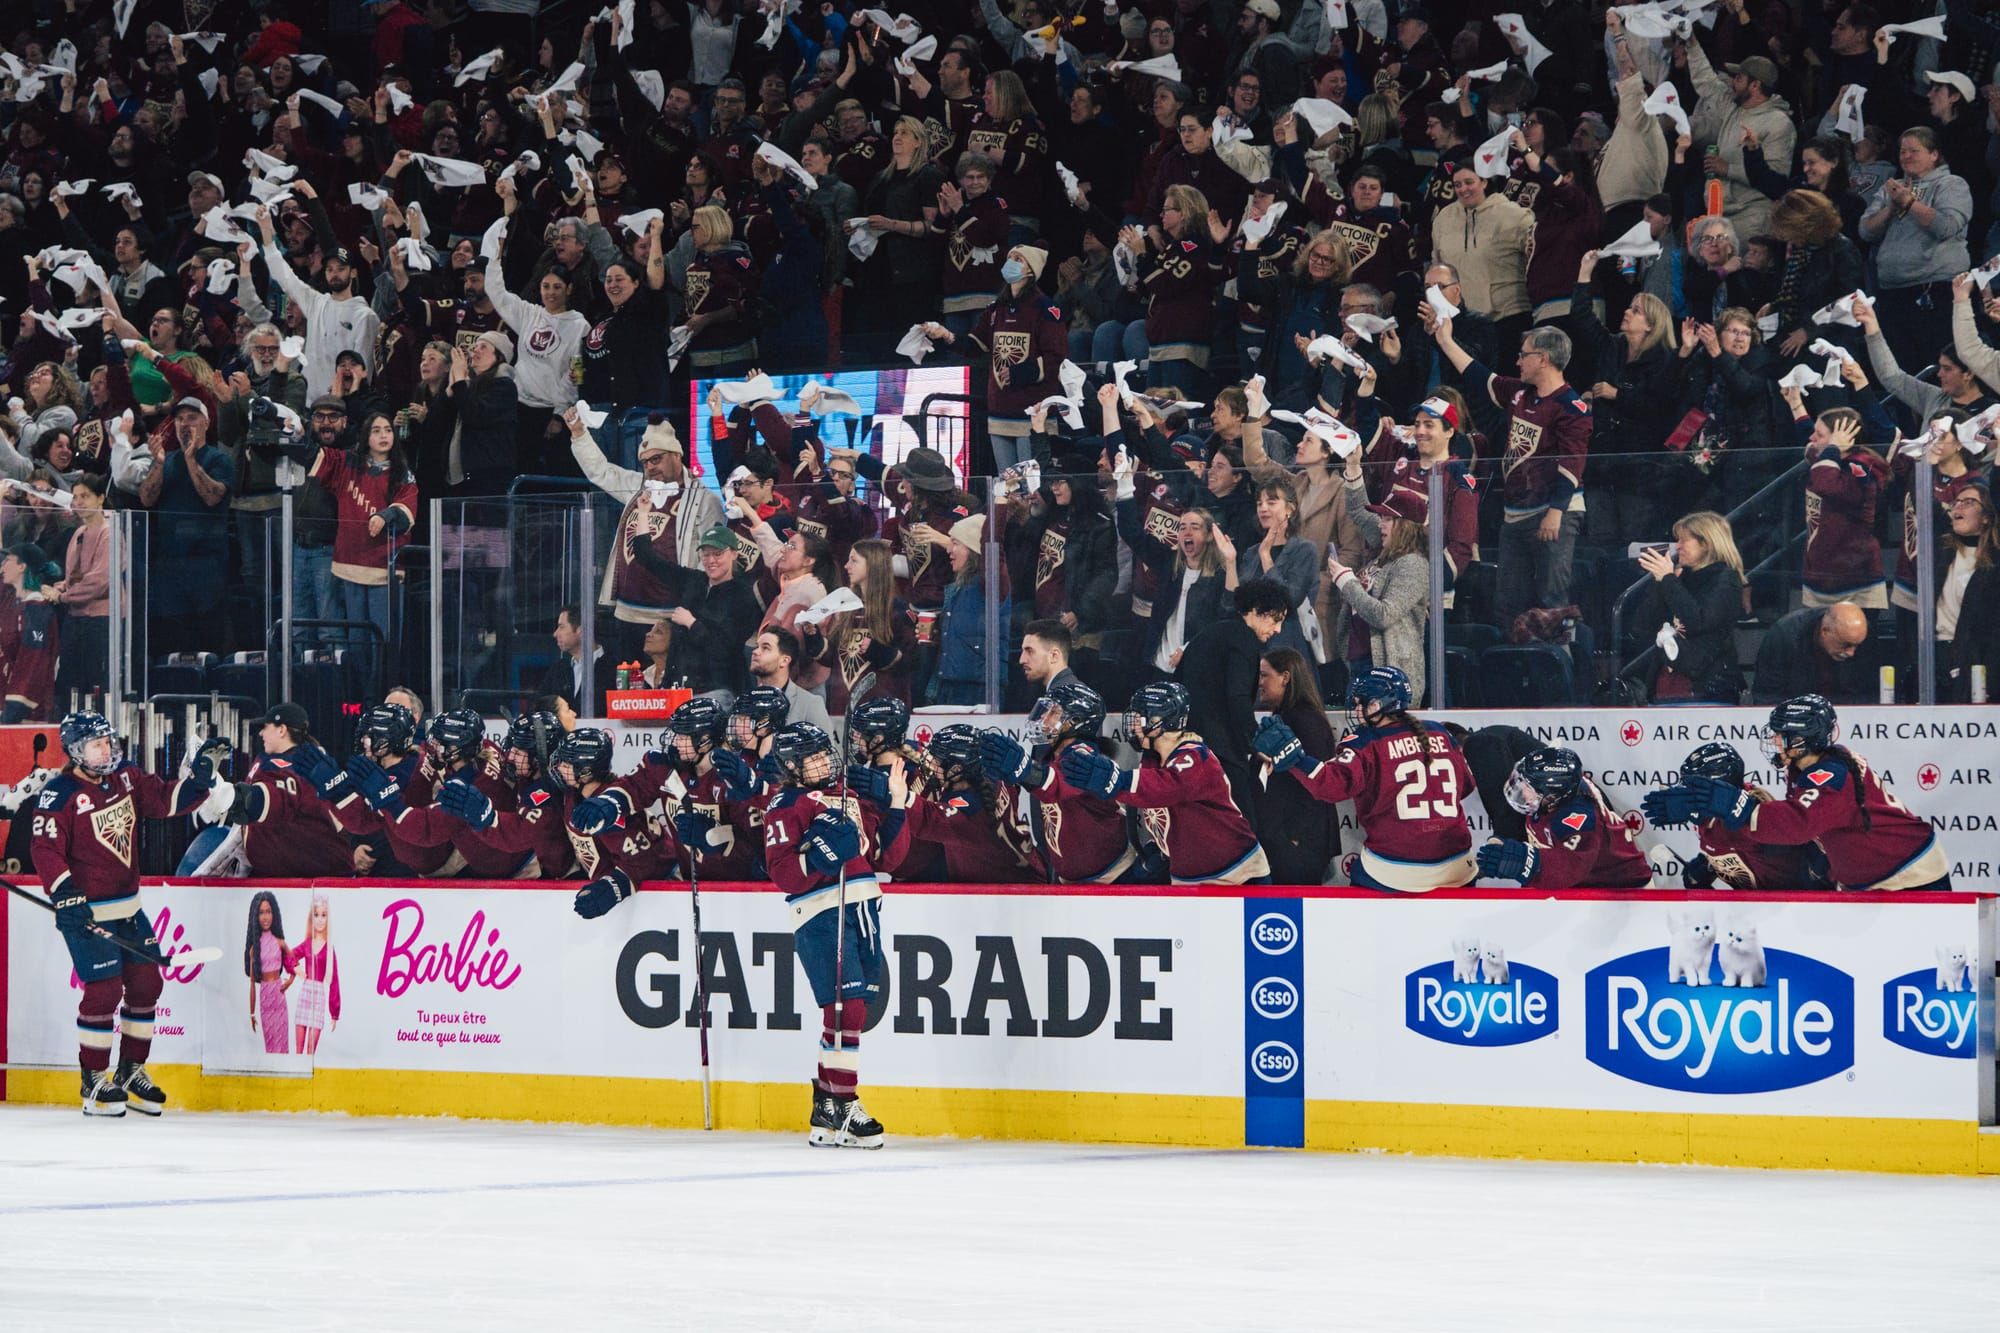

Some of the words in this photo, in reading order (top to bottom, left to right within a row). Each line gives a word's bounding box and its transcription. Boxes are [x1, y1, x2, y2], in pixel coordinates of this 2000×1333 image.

[79, 420, 101, 438] OIRE
[736, 540, 758, 560] OIRE
[611, 698, 666, 710] GATORADE
[623, 732, 653, 747] AIR
[1652, 725, 1691, 741] AIR
[1850, 723, 1889, 740] AIR
[1896, 722, 1998, 739] CANADA
[1602, 770, 1682, 787] CANAD
[1949, 768, 1992, 785] AIR
[1394, 758, 1458, 821] 23
[96, 801, 133, 829] VICTOIRE
[1339, 815, 1360, 830] AI
[1929, 815, 1998, 831] NADA
[32, 815, 59, 839] 24
[765, 820, 791, 848] 21
[622, 831, 651, 857] 43
[1951, 861, 1990, 878] AIR
[56, 895, 88, 910] CCM
[1258, 923, 1292, 943] Esso
[376, 898, 522, 998] Barbie
[1258, 987, 1292, 1007] Esso
[156, 1005, 171, 1017] tre
[1417, 976, 1548, 1039] Royale
[1896, 984, 1977, 1050] Roy
[417, 1010, 430, 1024] Tu
[432, 1012, 460, 1027] peux
[463, 1010, 487, 1024] être
[1606, 974, 1835, 1079] Royale
[158, 1023, 185, 1036] veux
[397, 1028, 419, 1042] tout
[421, 1031, 434, 1042] ce
[436, 1031, 457, 1048] que
[459, 1031, 471, 1044] tu
[473, 1033, 502, 1044] veux
[1258, 1051, 1292, 1071] Esso
